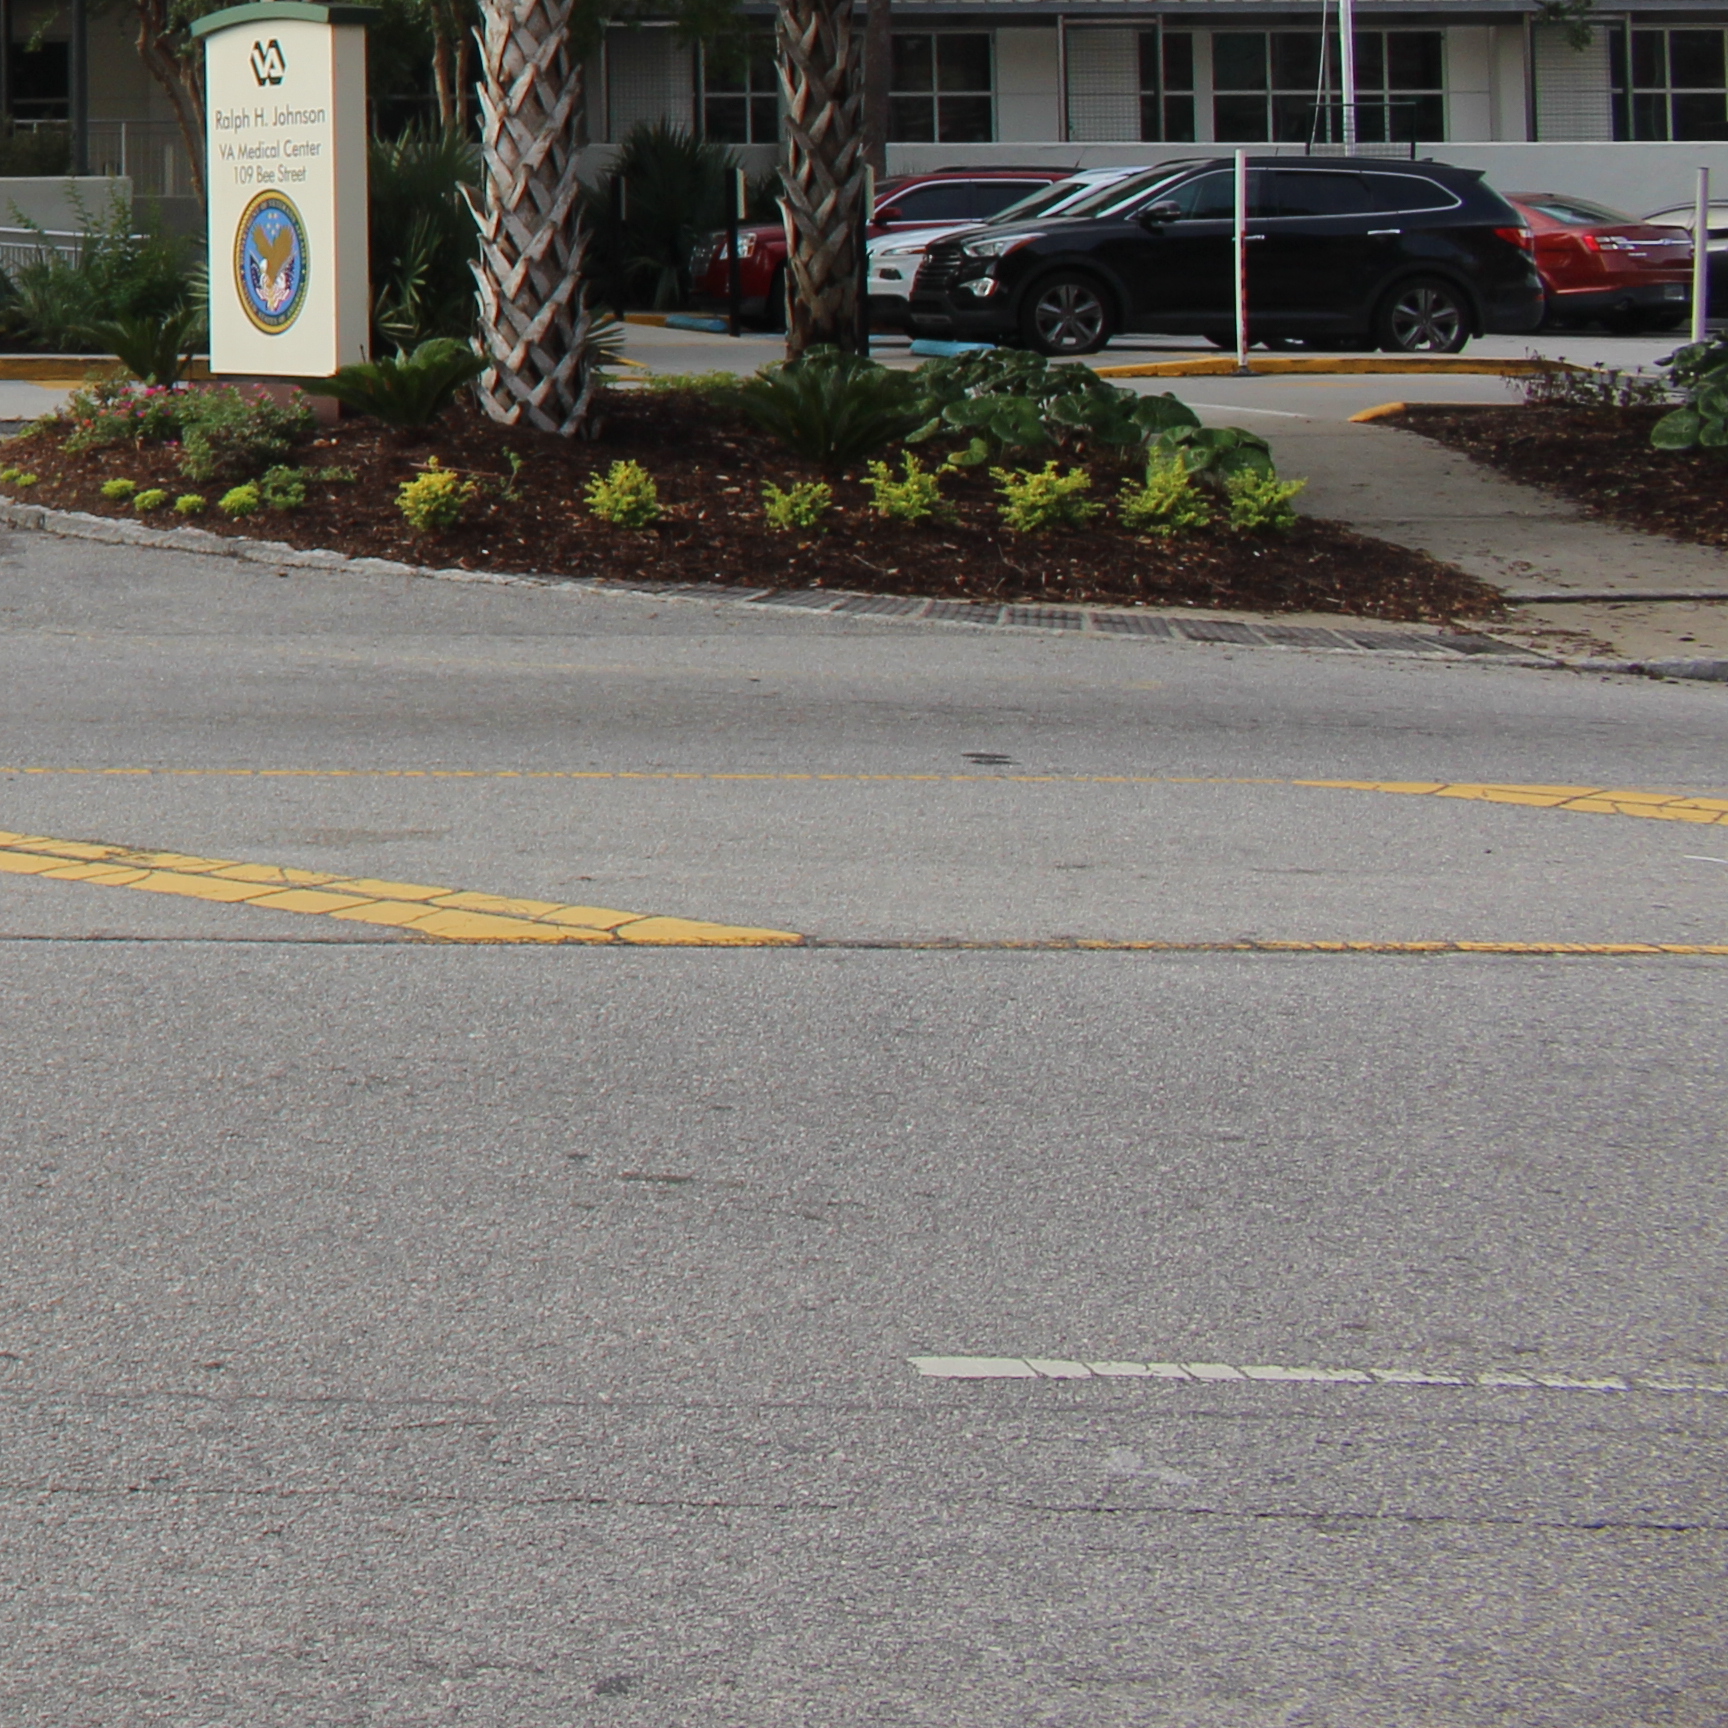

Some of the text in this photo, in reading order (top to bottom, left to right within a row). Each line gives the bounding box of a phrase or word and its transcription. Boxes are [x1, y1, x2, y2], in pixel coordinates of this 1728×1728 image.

[250, 39, 286, 87] VA
[215, 104, 325, 134] Ralph H. Johnson
[219, 139, 321, 160] VA Medical Center
[234, 164, 306, 184] 109 Bee Street
